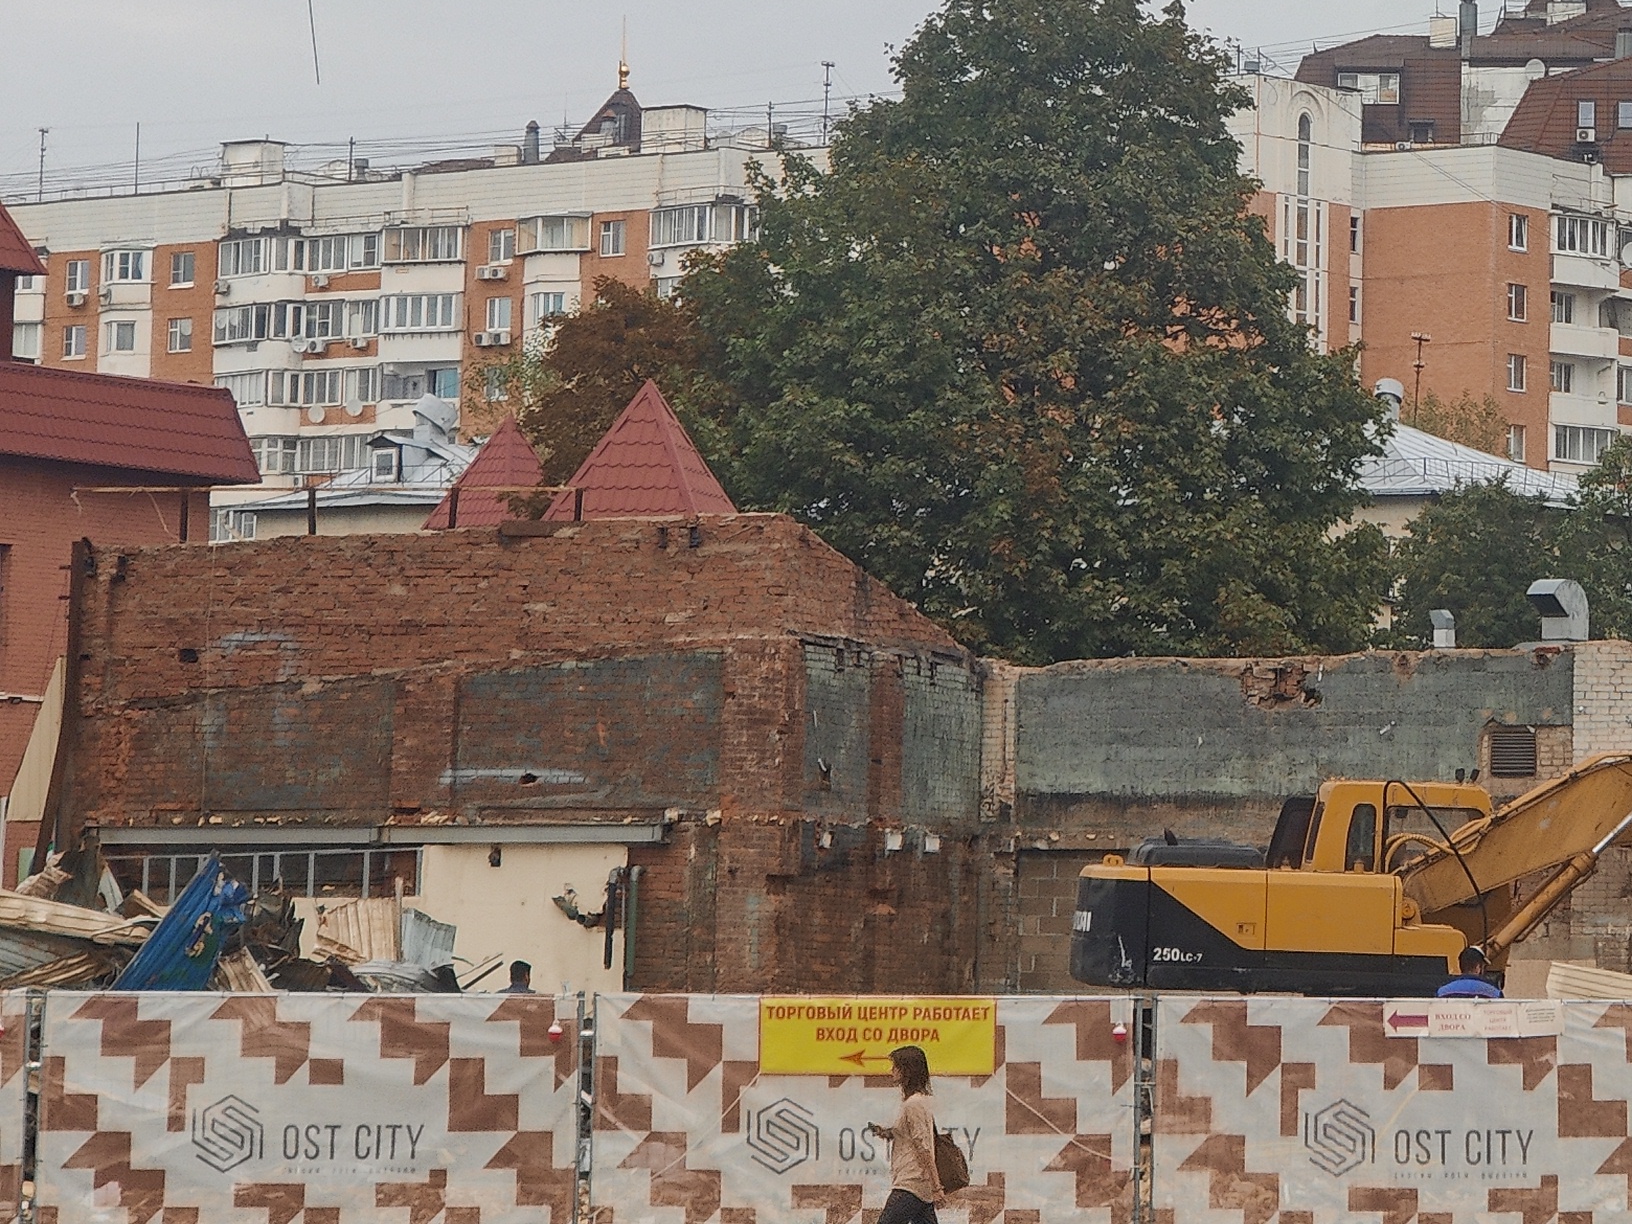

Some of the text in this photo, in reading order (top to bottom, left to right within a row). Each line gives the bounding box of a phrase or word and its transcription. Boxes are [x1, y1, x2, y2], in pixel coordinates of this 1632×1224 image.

[766, 1004, 990, 1021] ТОРГОВЫЙ ЦЕНТР РАБОТАЕТ
[816, 1028, 940, 1044] ВХОД СО ДВОРА
[283, 1124, 424, 1160] OST CITY
[1394, 1129, 1534, 1165] OST CITY
